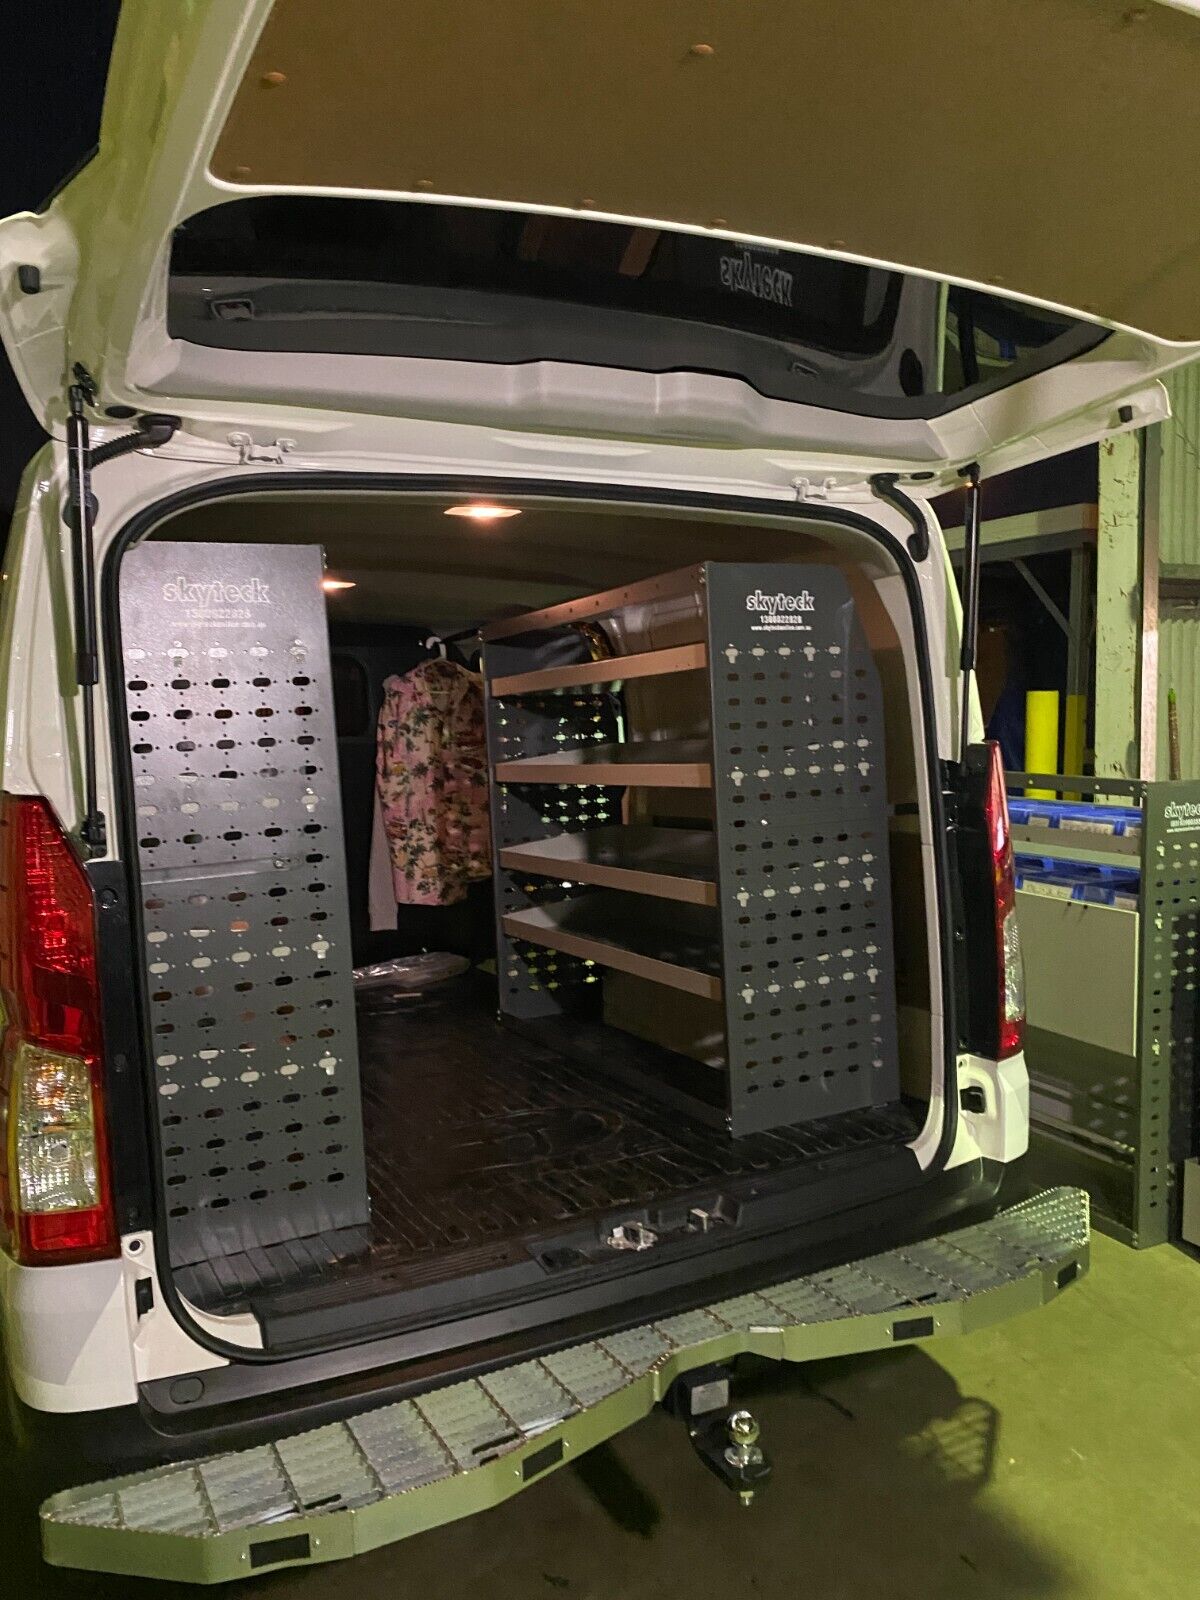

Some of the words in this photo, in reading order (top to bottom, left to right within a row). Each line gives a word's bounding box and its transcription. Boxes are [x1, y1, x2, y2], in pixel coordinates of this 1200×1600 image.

[163, 576, 271, 607] skyteck
[746, 589, 815, 615] skyteck
[1164, 800, 1200, 821] skytec
